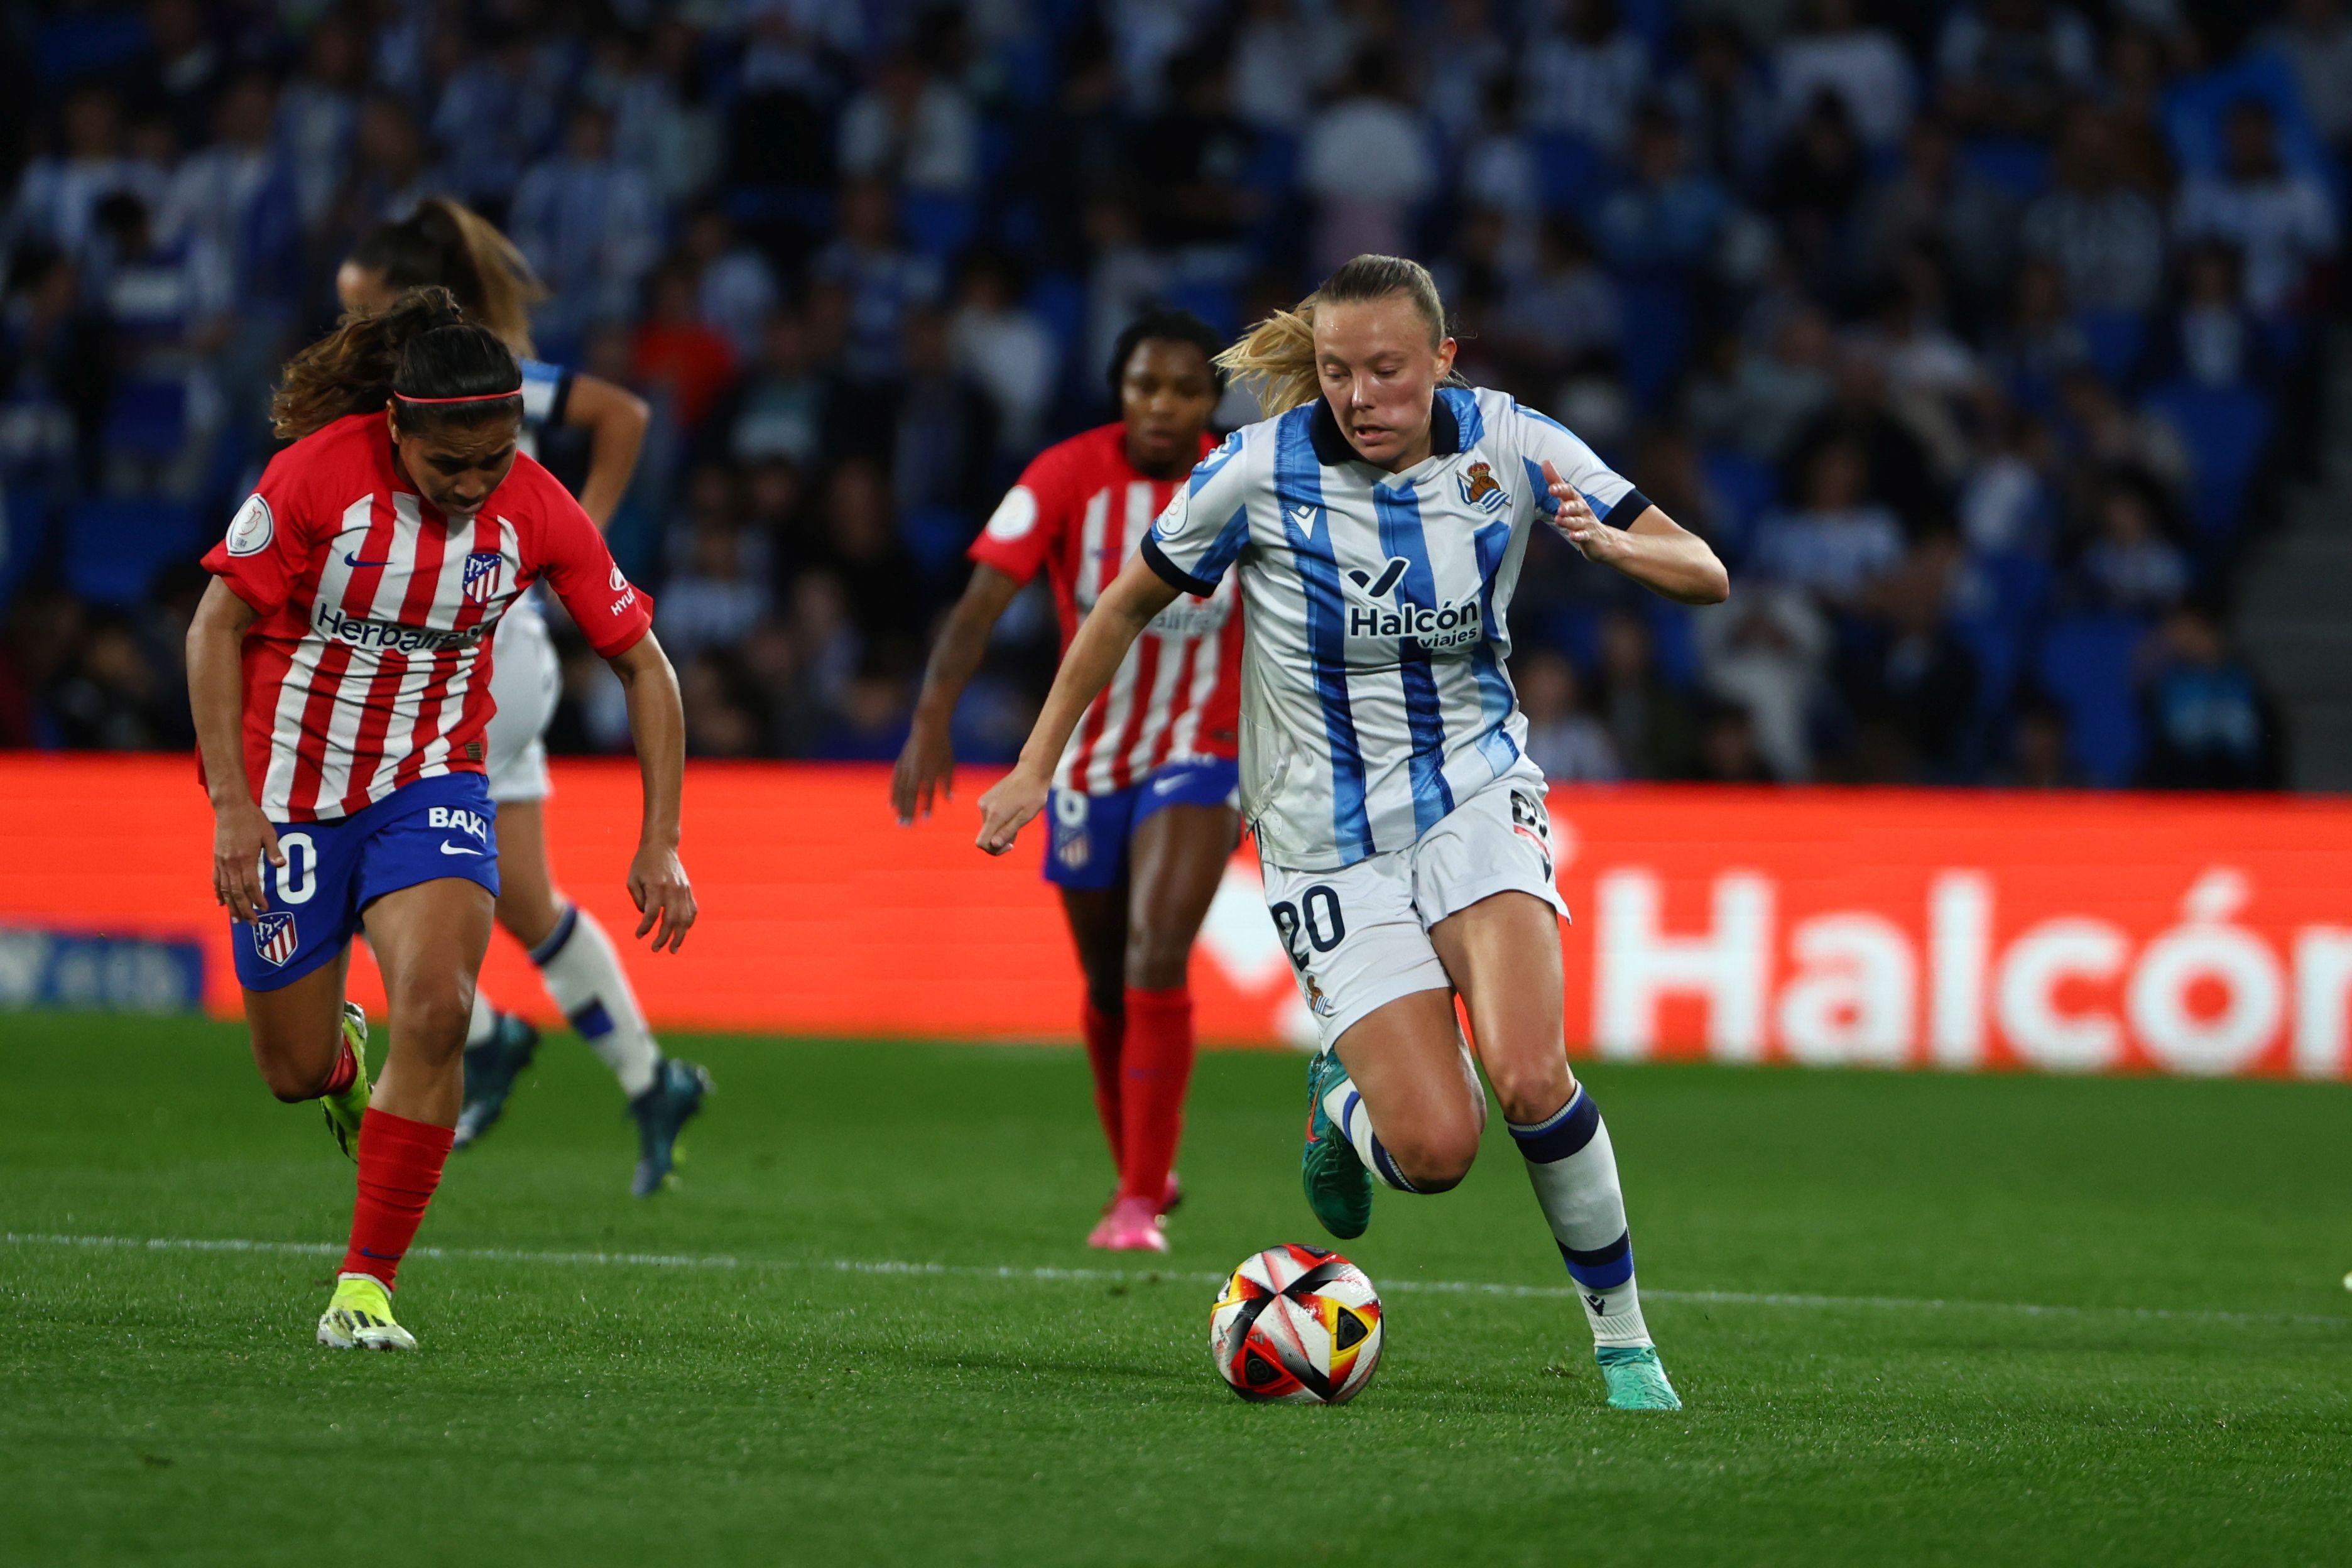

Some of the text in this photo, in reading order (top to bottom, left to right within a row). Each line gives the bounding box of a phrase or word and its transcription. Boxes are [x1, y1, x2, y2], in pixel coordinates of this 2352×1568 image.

[1351, 601, 1478, 636] Halcón
[1420, 628, 1476, 647] viajes
[1271, 885, 1346, 972] 20
